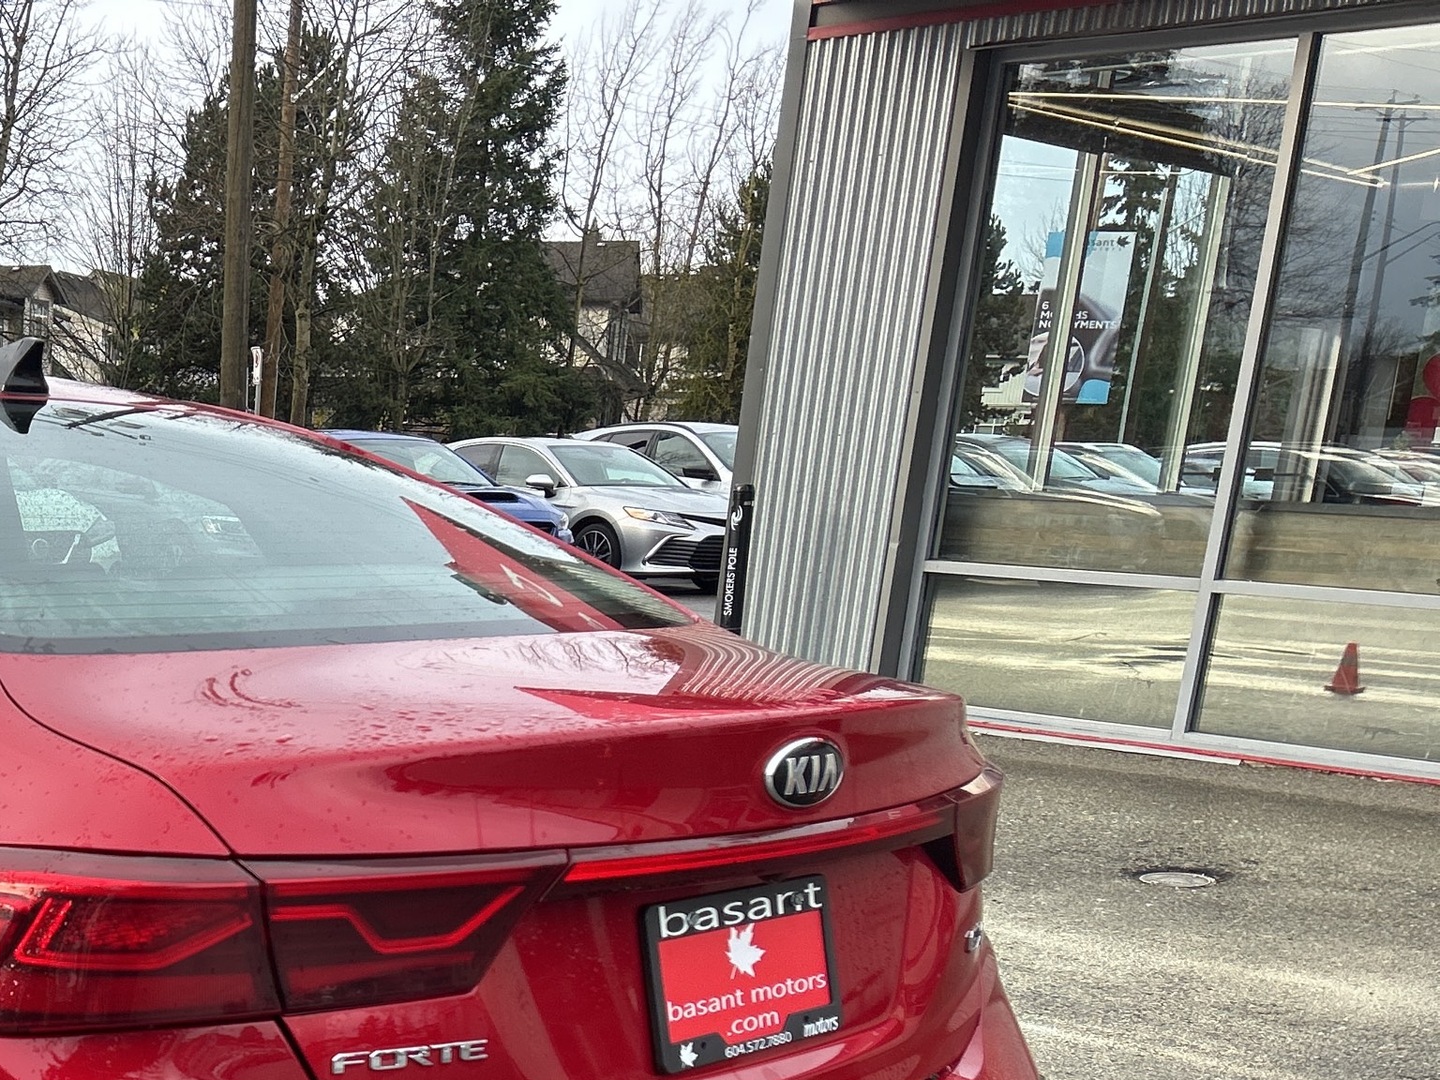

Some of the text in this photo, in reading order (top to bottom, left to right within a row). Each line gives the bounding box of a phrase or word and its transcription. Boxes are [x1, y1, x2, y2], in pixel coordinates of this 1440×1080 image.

[1041, 301, 1050, 310] 6
[1073, 319, 1117, 330] YMENTS
[723, 547, 738, 616] SMOKERS POLE
[784, 753, 838, 796] KIA
[666, 973, 827, 1022] basant motors
[727, 1011, 780, 1036] .com
[803, 1016, 839, 1038] motors
[331, 1039, 489, 1075] FORTE
[724, 1031, 793, 1058] 604.572.7880
